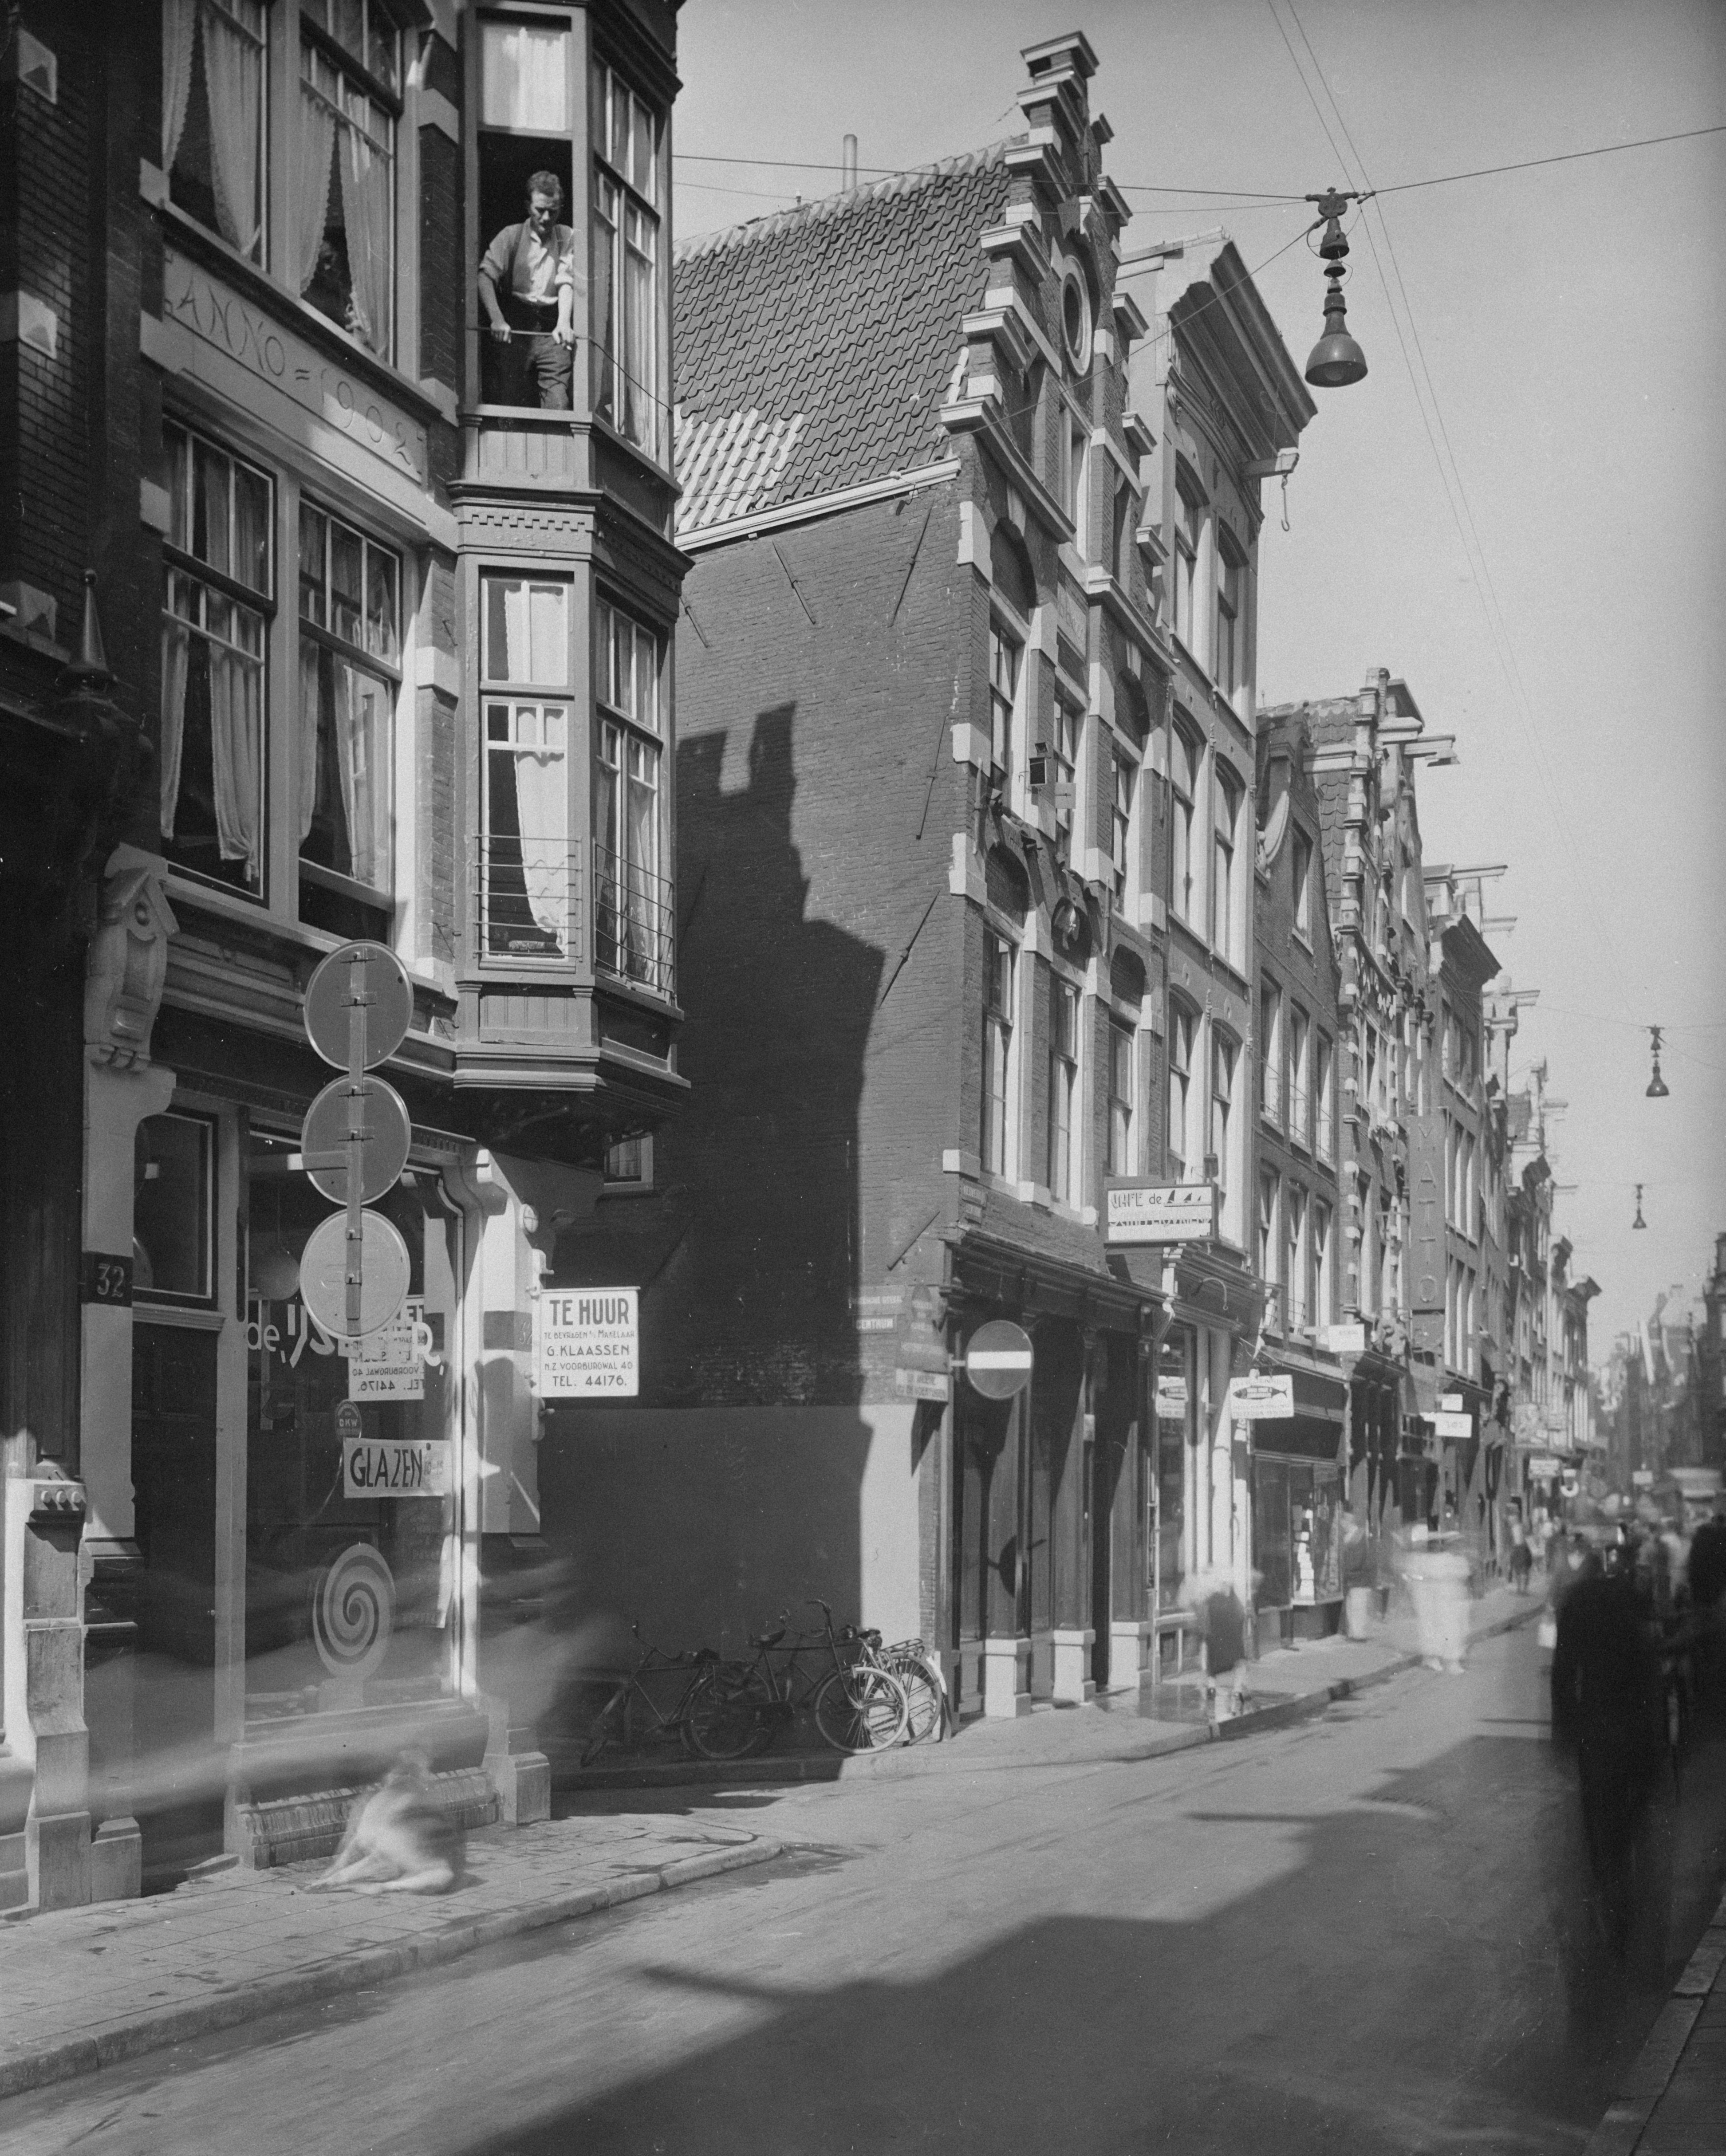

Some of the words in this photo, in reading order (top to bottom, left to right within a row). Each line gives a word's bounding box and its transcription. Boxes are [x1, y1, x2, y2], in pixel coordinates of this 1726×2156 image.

[176, 275, 285, 376] ANNO
[1149, 1193, 1162, 1204] de
[96, 1263, 124, 1297] 32
[549, 1299, 573, 1326] TE
[579, 1298, 629, 1325] HUUR
[248, 1300, 280, 1352] de
[598, 1329, 634, 1338] MAKELAAR
[560, 1345, 630, 1356] KLAASSEN
[560, 1361, 618, 1370] VOORBURGWAL
[621, 1361, 633, 1369] 40
[553, 1376, 577, 1386] TEL.
[339, 1419, 358, 1427] DKW
[350, 1447, 422, 1487] GLAZEN
